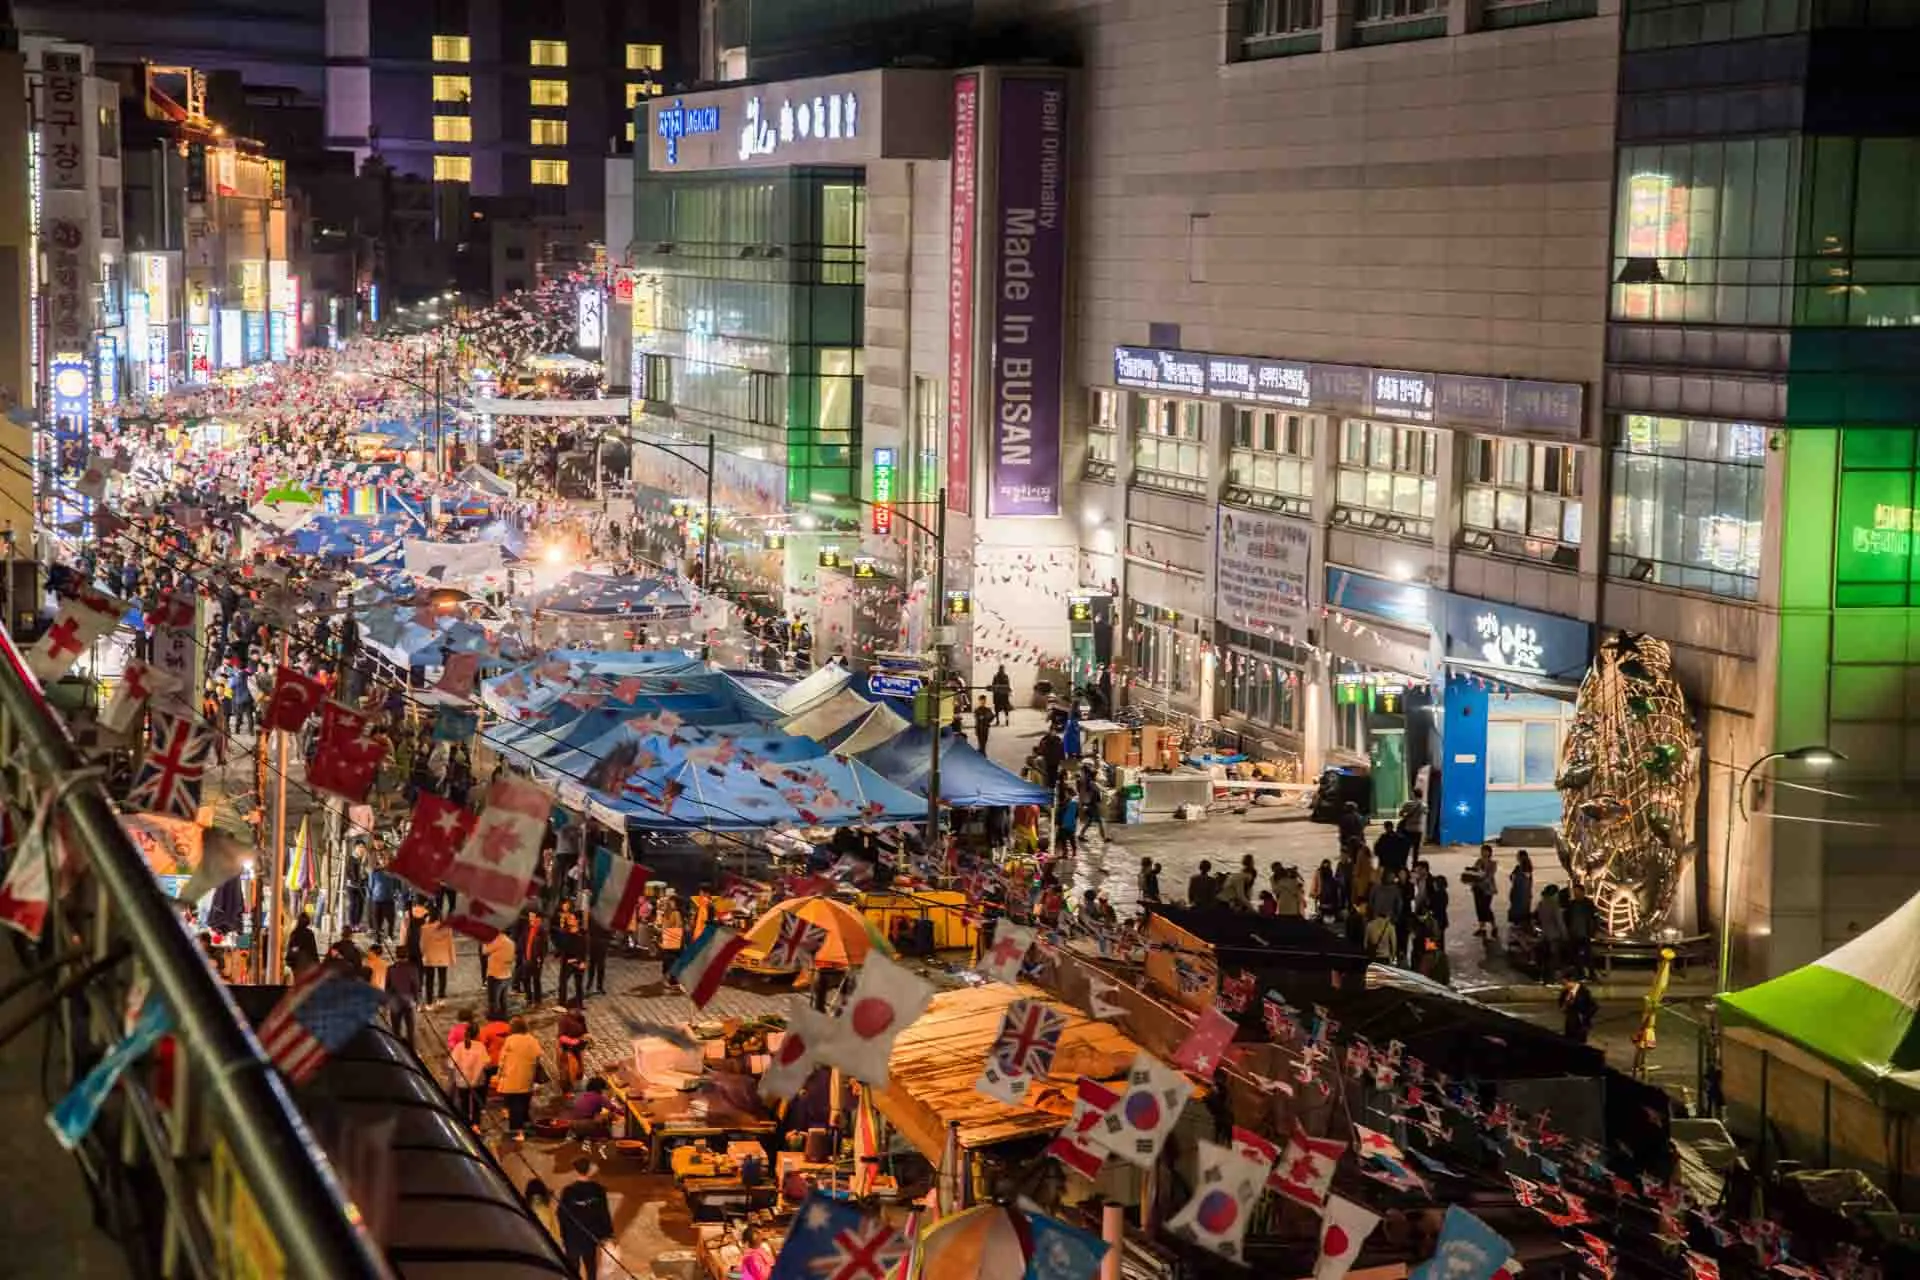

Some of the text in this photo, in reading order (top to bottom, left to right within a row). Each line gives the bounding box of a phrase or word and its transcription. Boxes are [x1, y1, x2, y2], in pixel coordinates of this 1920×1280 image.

[686, 107, 718, 134] JAGALCHI
[1040, 91, 1060, 229] Real Originality
[950, 93, 968, 461] Global Seafood Market
[1001, 207, 1036, 466] Made In BUSAN
